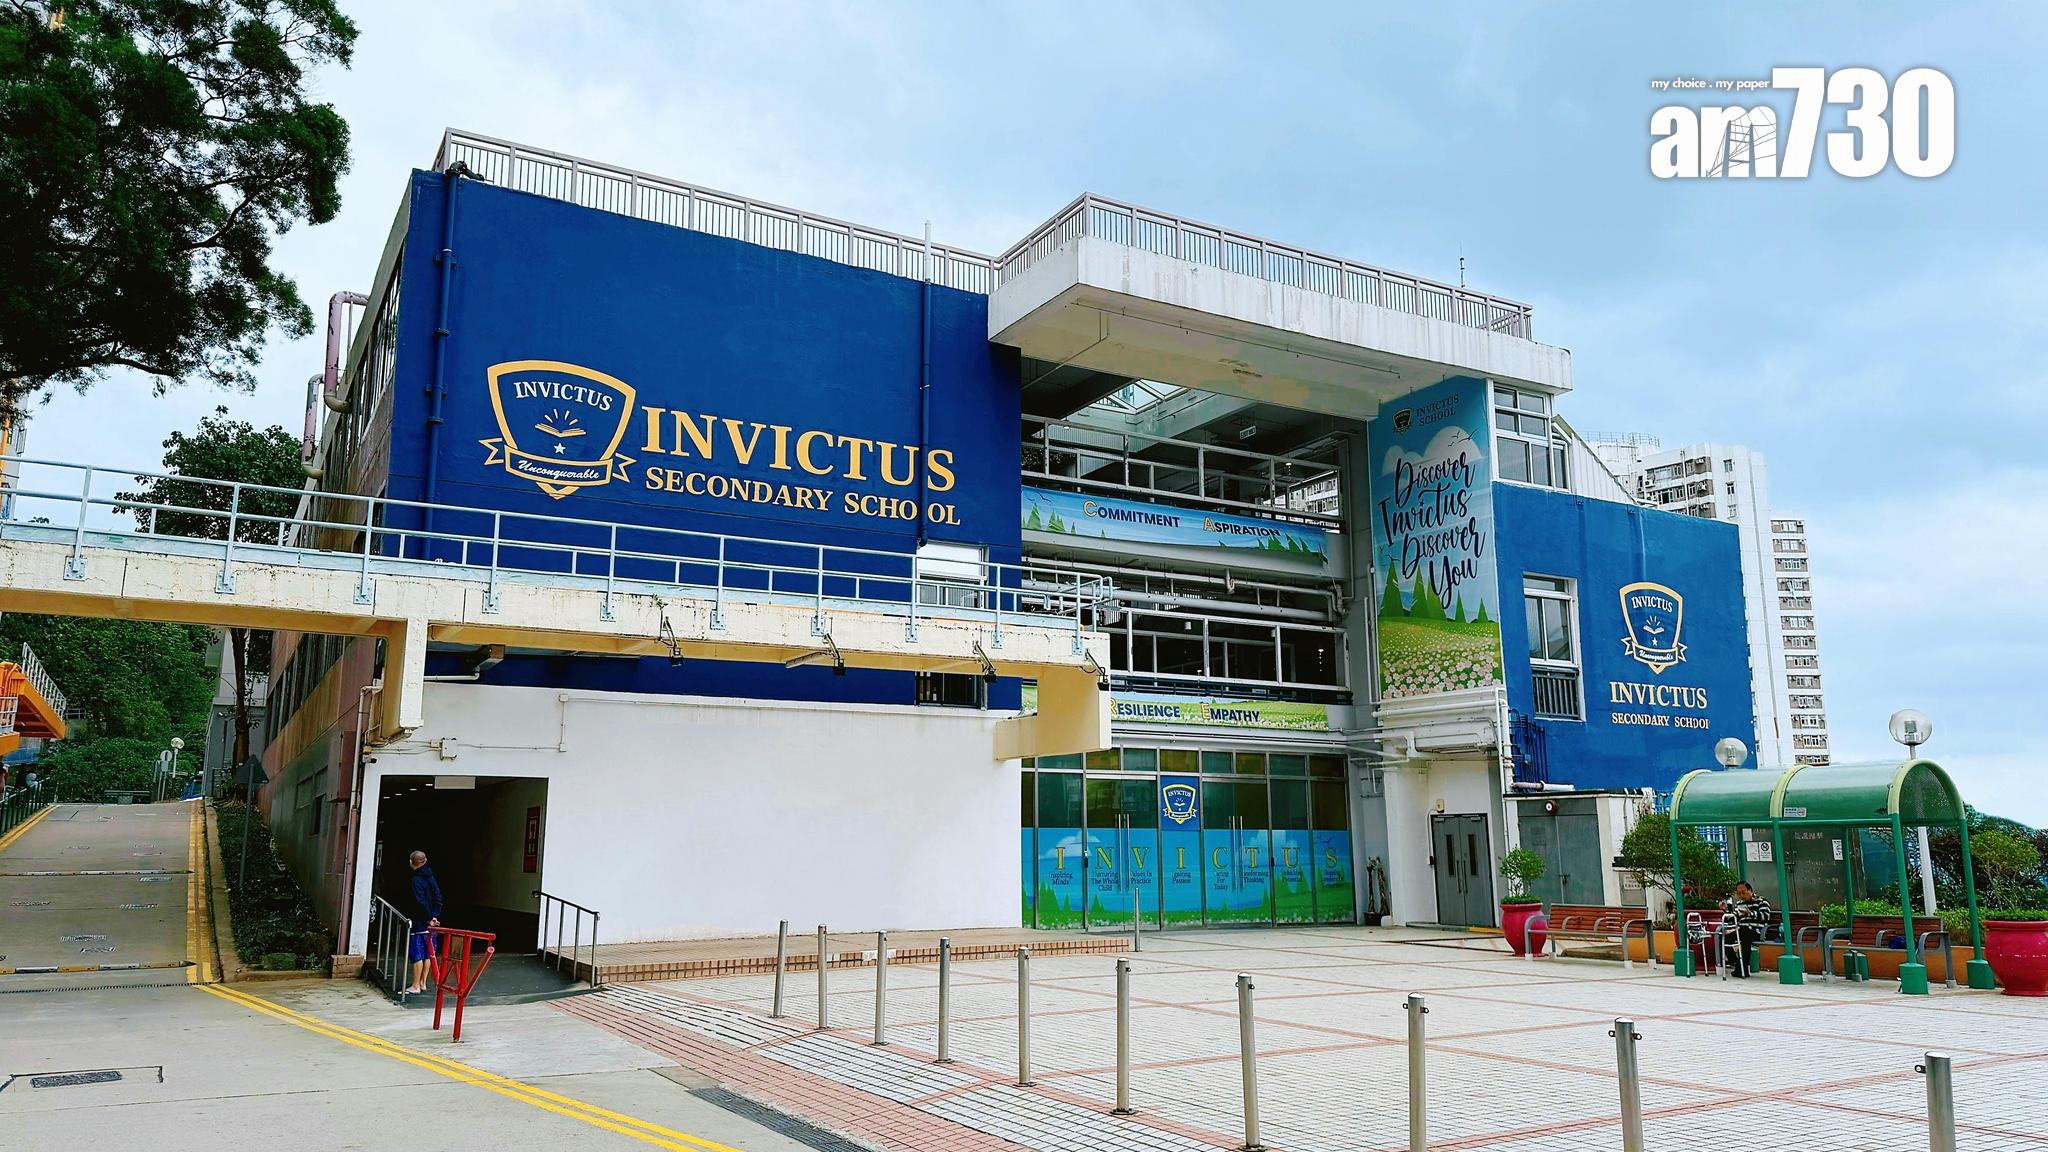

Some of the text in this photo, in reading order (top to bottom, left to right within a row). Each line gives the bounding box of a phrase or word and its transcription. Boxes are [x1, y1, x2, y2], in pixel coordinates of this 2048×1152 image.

[513, 380, 614, 412] INVICTUS
[1416, 393, 1459, 417] INVICTUS
[1419, 407, 1457, 427] SCHOOL
[641, 404, 955, 491] INVICTUS
[518, 459, 600, 480] Unconquerable
[1395, 451, 1476, 508] Discover
[645, 466, 961, 526] SECONDARY SCHOOL
[1083, 500, 1281, 537] COMMITMENT ASPIRATION
[1377, 482, 1472, 547] Invictus
[1402, 517, 1486, 579] Discover
[1429, 556, 1478, 609] You
[1631, 595, 1673, 613] INVICTUS
[1609, 681, 1708, 709] INVICTUS
[1201, 701, 1260, 722] EMPATHY
[1612, 712, 1670, 727] SECONDARY
